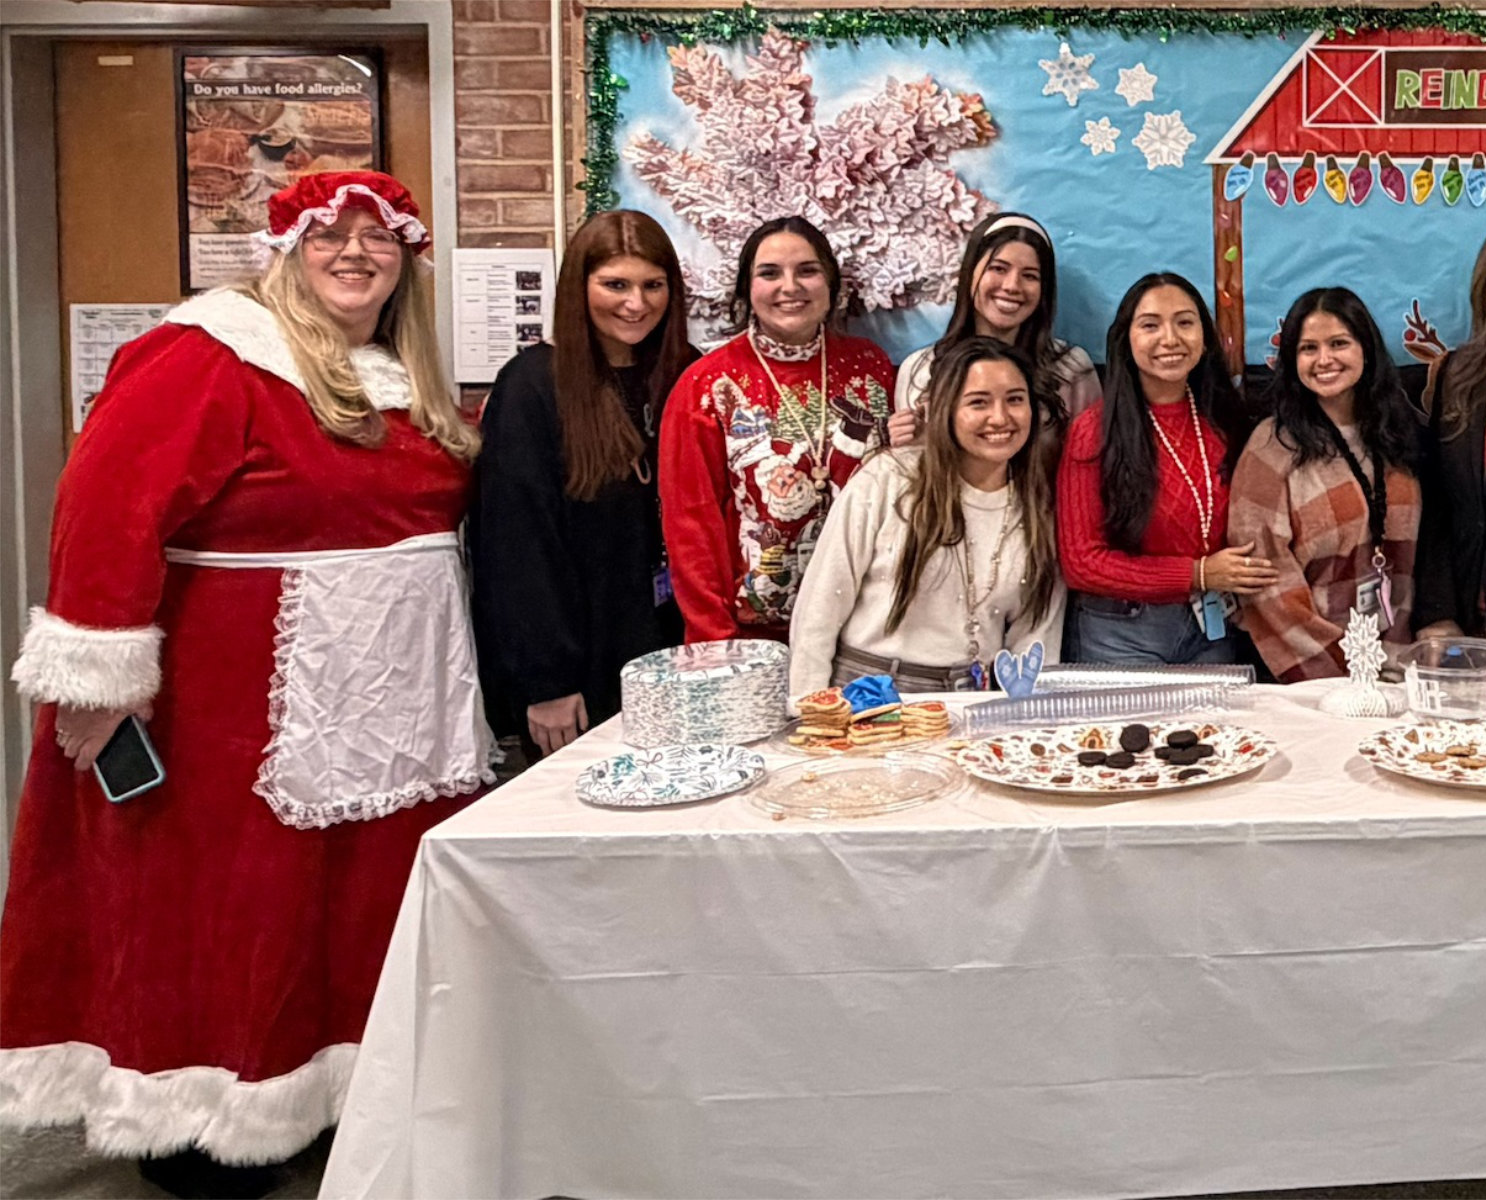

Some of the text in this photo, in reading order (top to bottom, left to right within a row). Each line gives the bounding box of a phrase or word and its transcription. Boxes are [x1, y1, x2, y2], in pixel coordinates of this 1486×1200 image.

[193, 83, 363, 95] Do you have food allergies?
